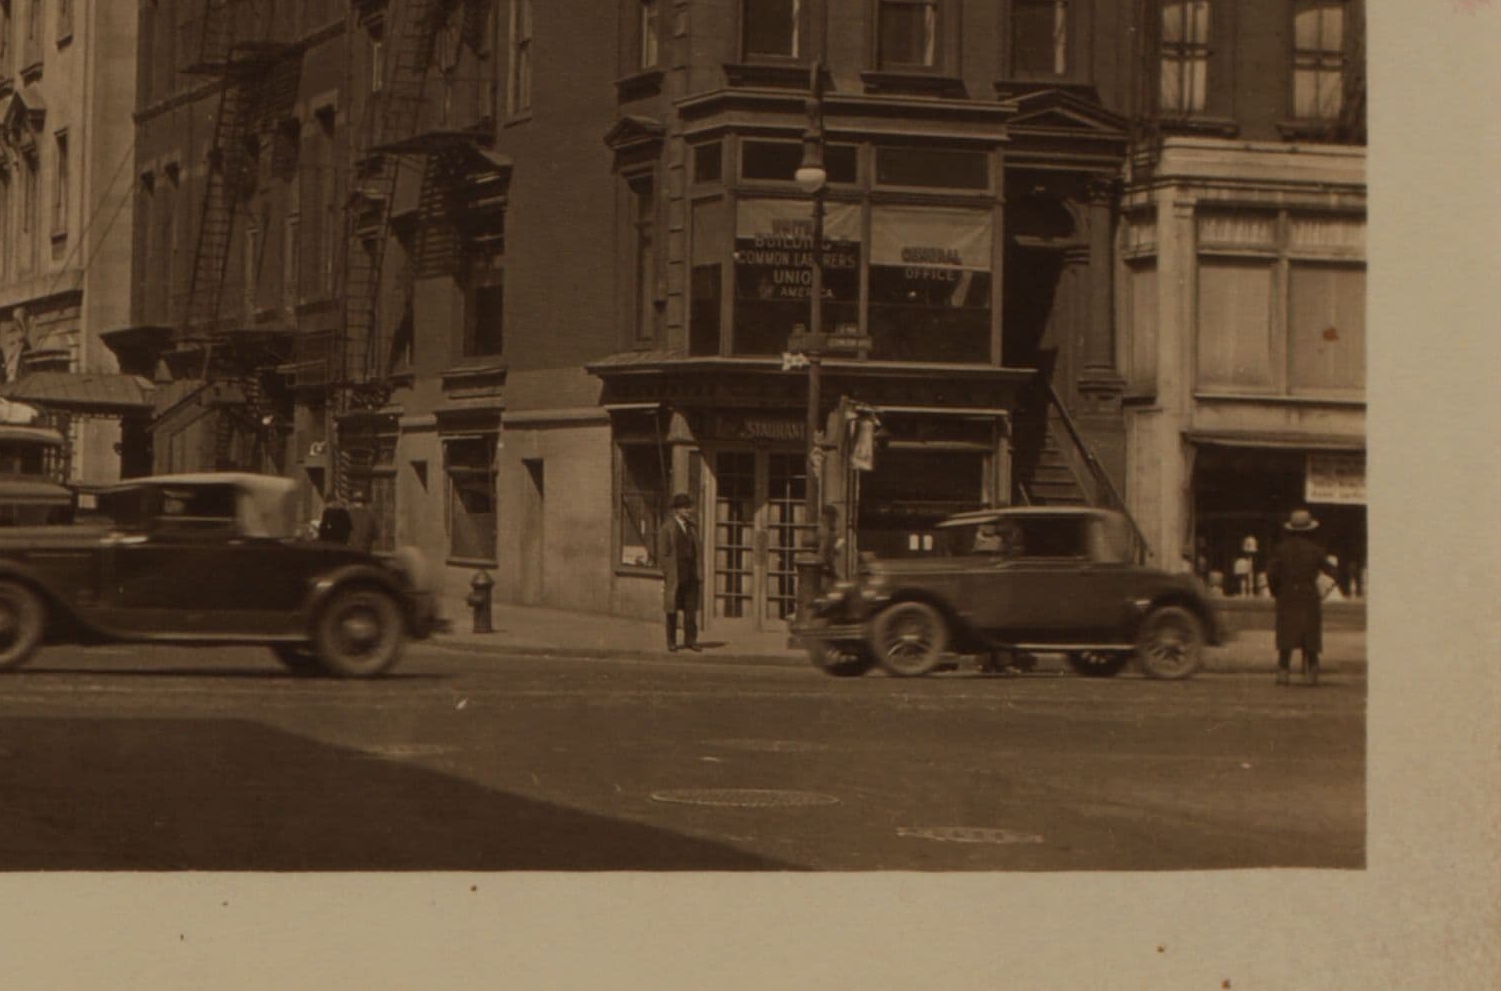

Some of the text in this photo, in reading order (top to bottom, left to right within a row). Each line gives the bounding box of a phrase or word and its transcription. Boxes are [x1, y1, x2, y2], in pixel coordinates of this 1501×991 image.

[737, 249, 856, 269] COMMON LABRERS
[772, 269, 814, 285] UNIO
[905, 268, 957, 282] OFFICE
